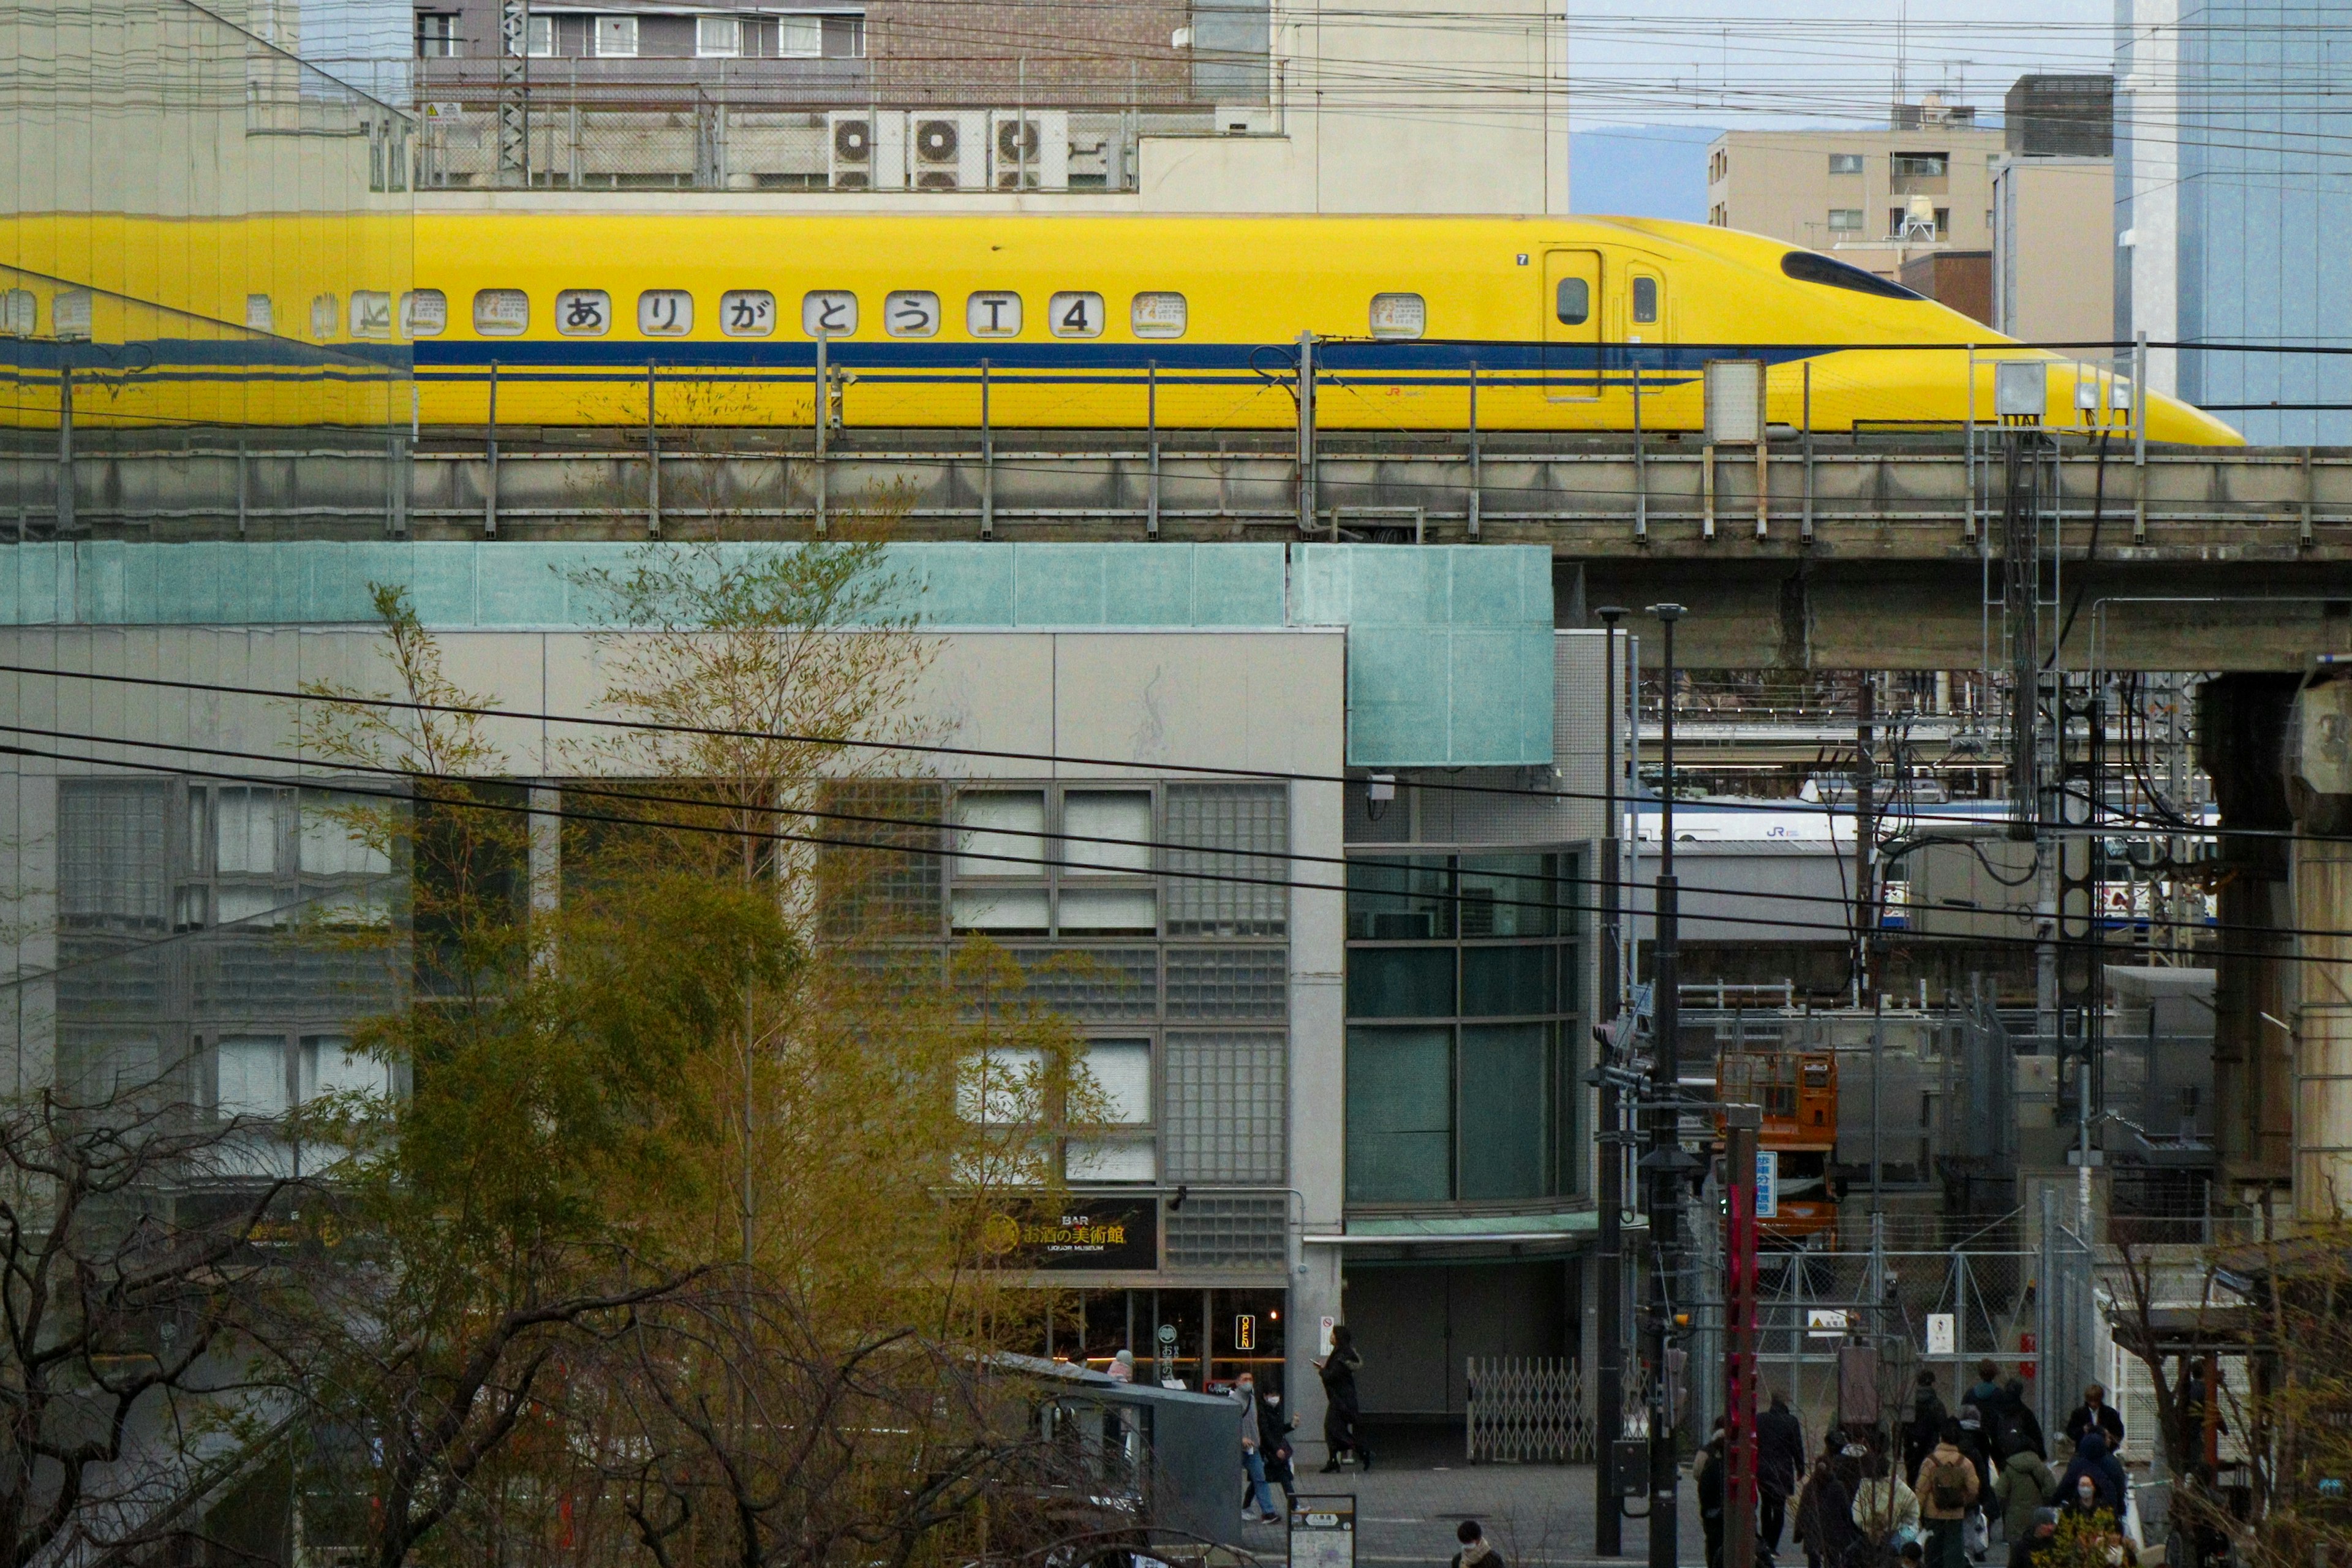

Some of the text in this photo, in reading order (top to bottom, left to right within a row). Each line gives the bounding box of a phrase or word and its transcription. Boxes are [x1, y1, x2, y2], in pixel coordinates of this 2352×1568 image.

[1518, 254, 1527, 265] 7
[1386, 387, 1400, 396] JR
[1766, 827, 1784, 837] JR
[1061, 1216, 1088, 1226] BAR
[1023, 1226, 1125, 1245] お酒の美術館
